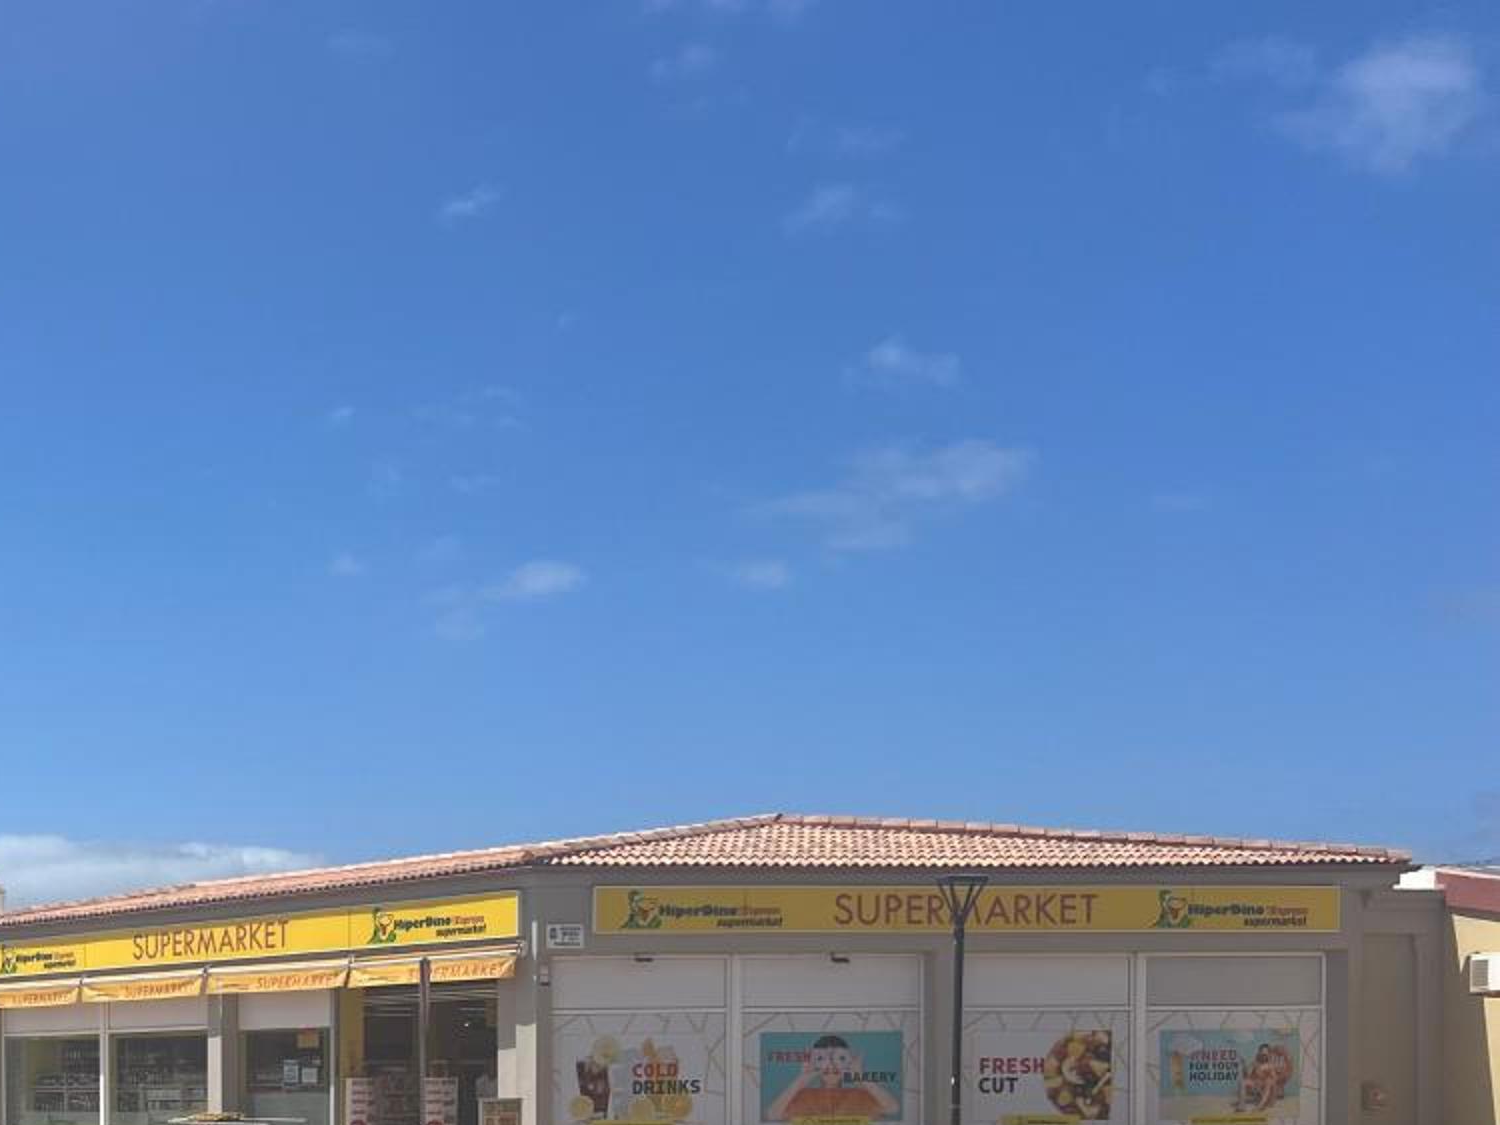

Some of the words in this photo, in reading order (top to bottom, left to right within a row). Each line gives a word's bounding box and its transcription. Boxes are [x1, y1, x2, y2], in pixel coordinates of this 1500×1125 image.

[659, 904, 738, 918] HiperDino
[835, 893, 1099, 925] SUPERMARKET
[1187, 904, 1265, 918] HiperDino
[394, 915, 451, 932] HiperDino
[1244, 916, 1308, 927] supermarket
[436, 924, 487, 938] supermarket
[133, 919, 290, 960] SUPERMARKET
[631, 1063, 679, 1078] COLD
[979, 1057, 1045, 1074] FRESH
[1189, 1062, 1210, 1071] FOR
[843, 1071, 897, 1083] BAKERY
[1189, 1071, 1239, 1082] HOLIDAY
[632, 1079, 702, 1095] DRINKS
[979, 1077, 1019, 1093] CUT
